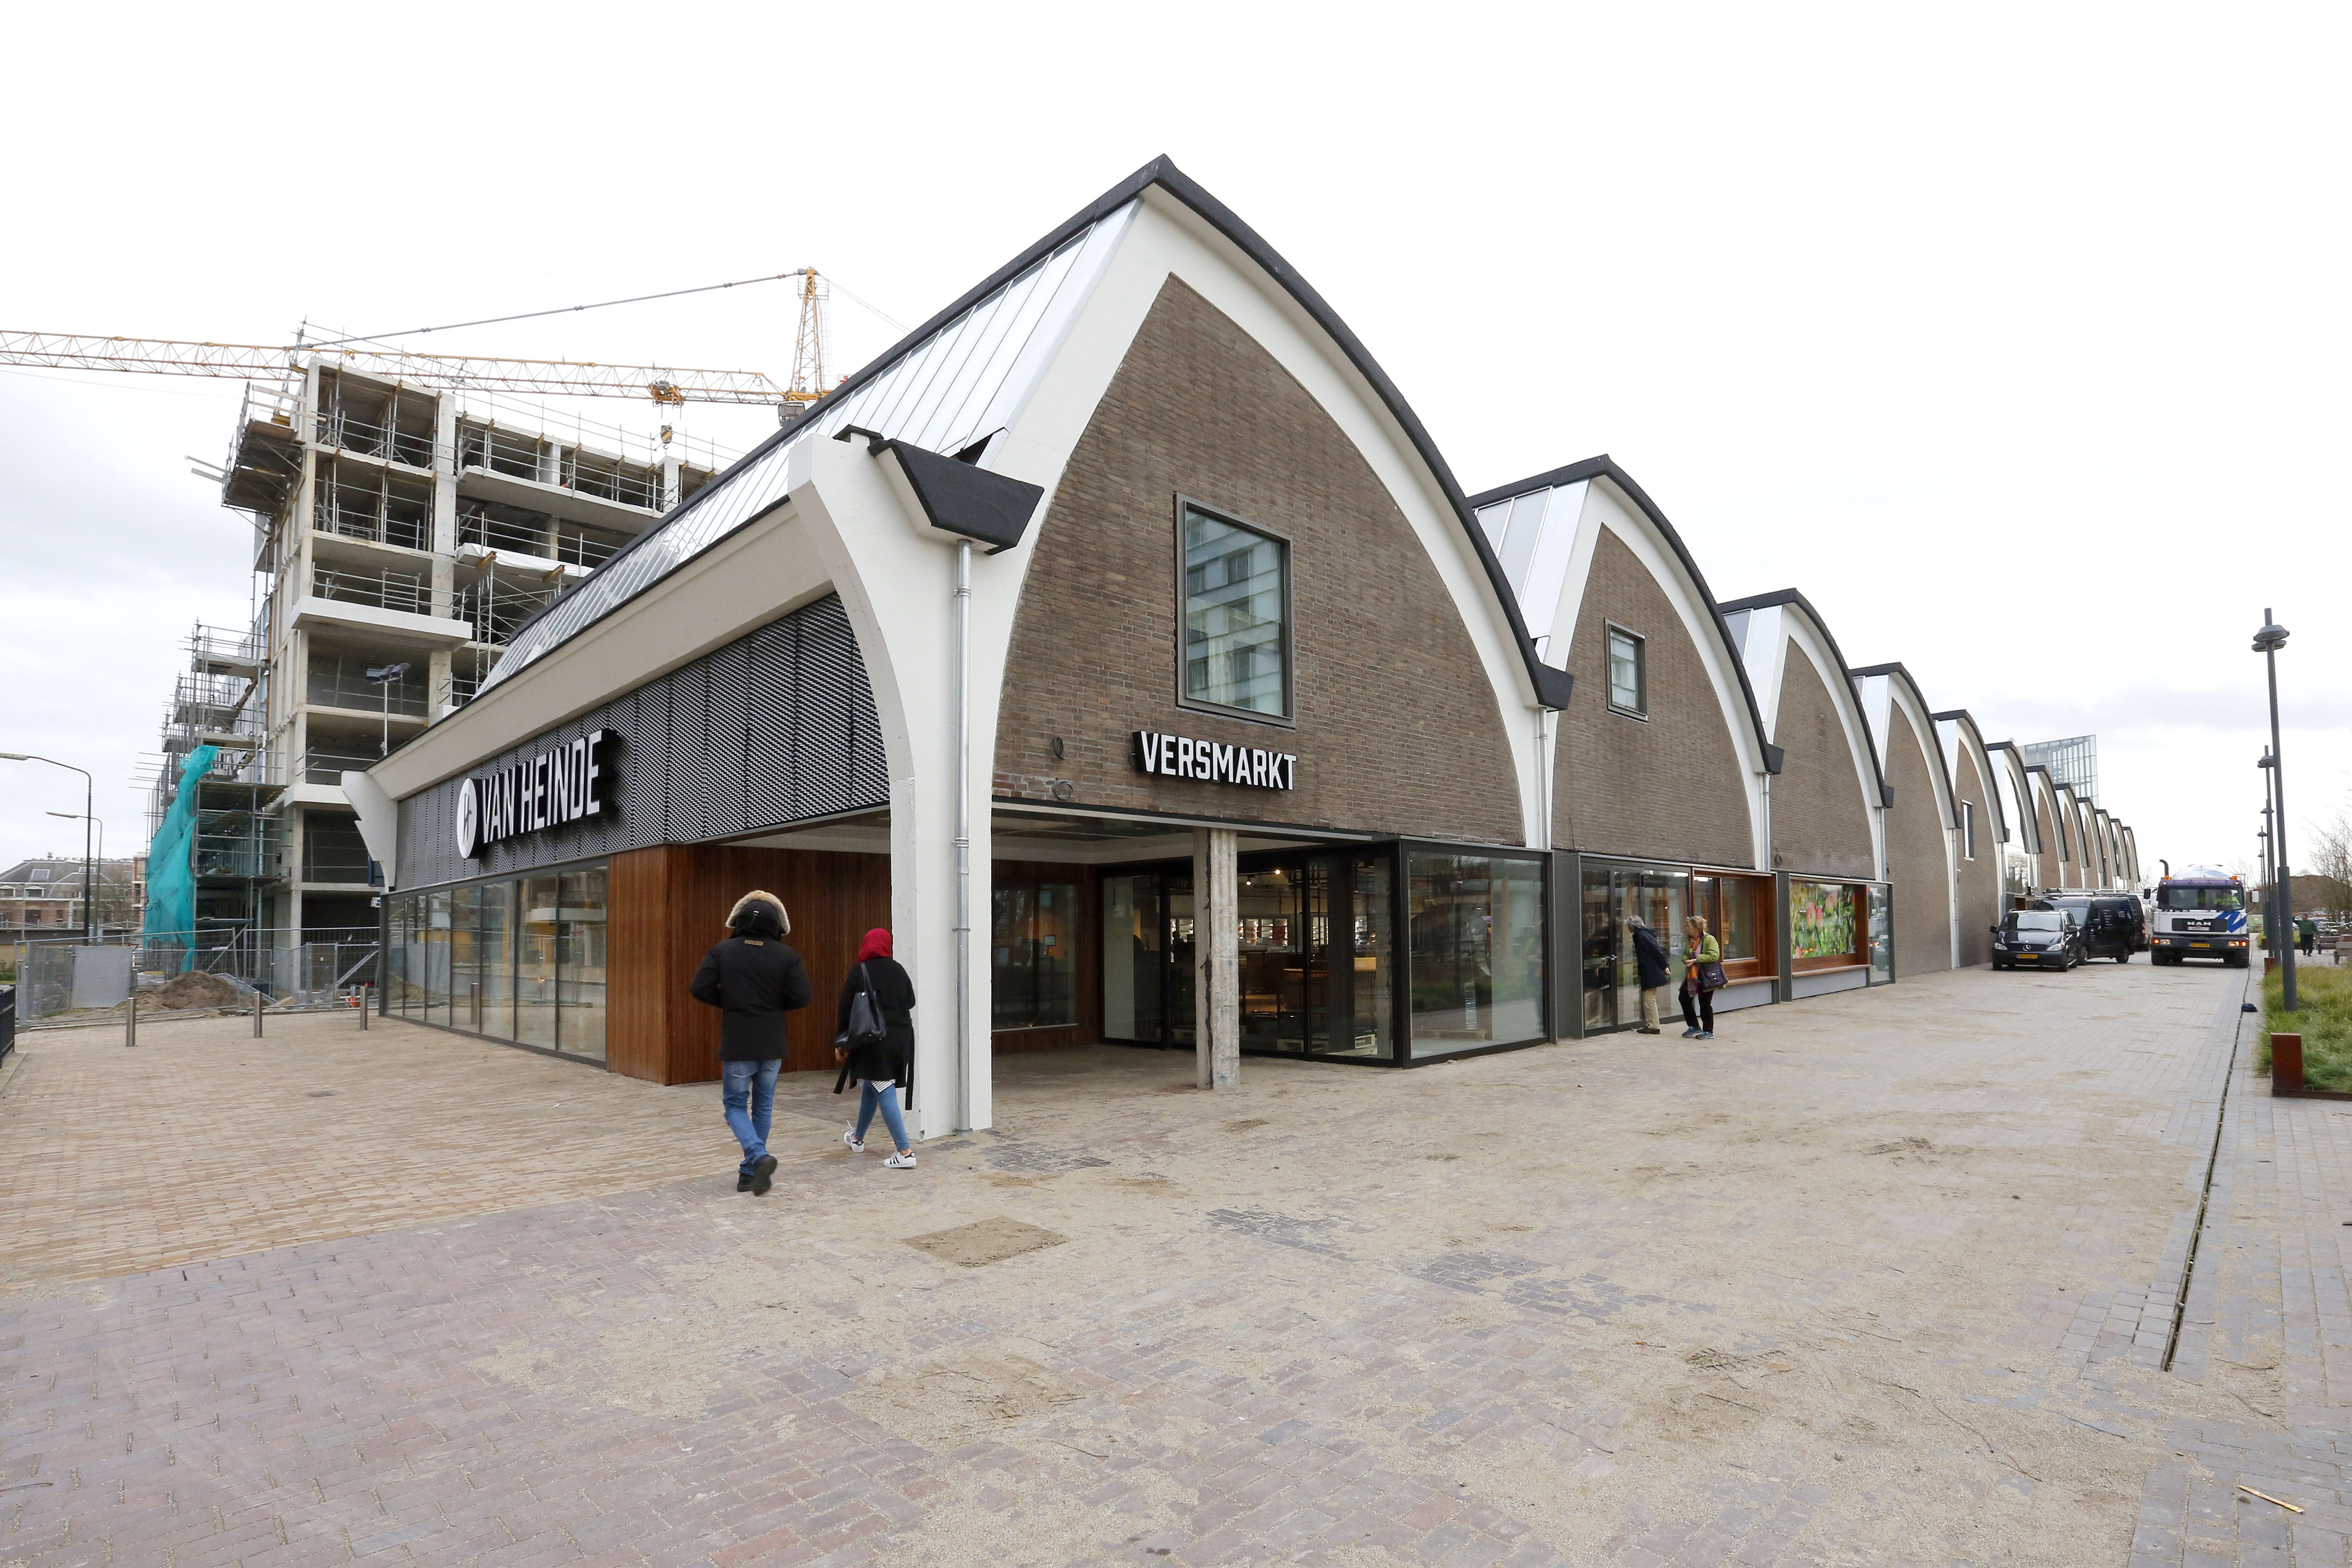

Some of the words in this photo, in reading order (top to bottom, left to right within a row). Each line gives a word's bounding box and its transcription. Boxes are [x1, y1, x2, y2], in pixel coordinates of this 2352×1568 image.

[482, 766, 516, 844] VAN
[520, 730, 603, 833] HEINDE
[1141, 730, 1297, 790] VERSMARKT
